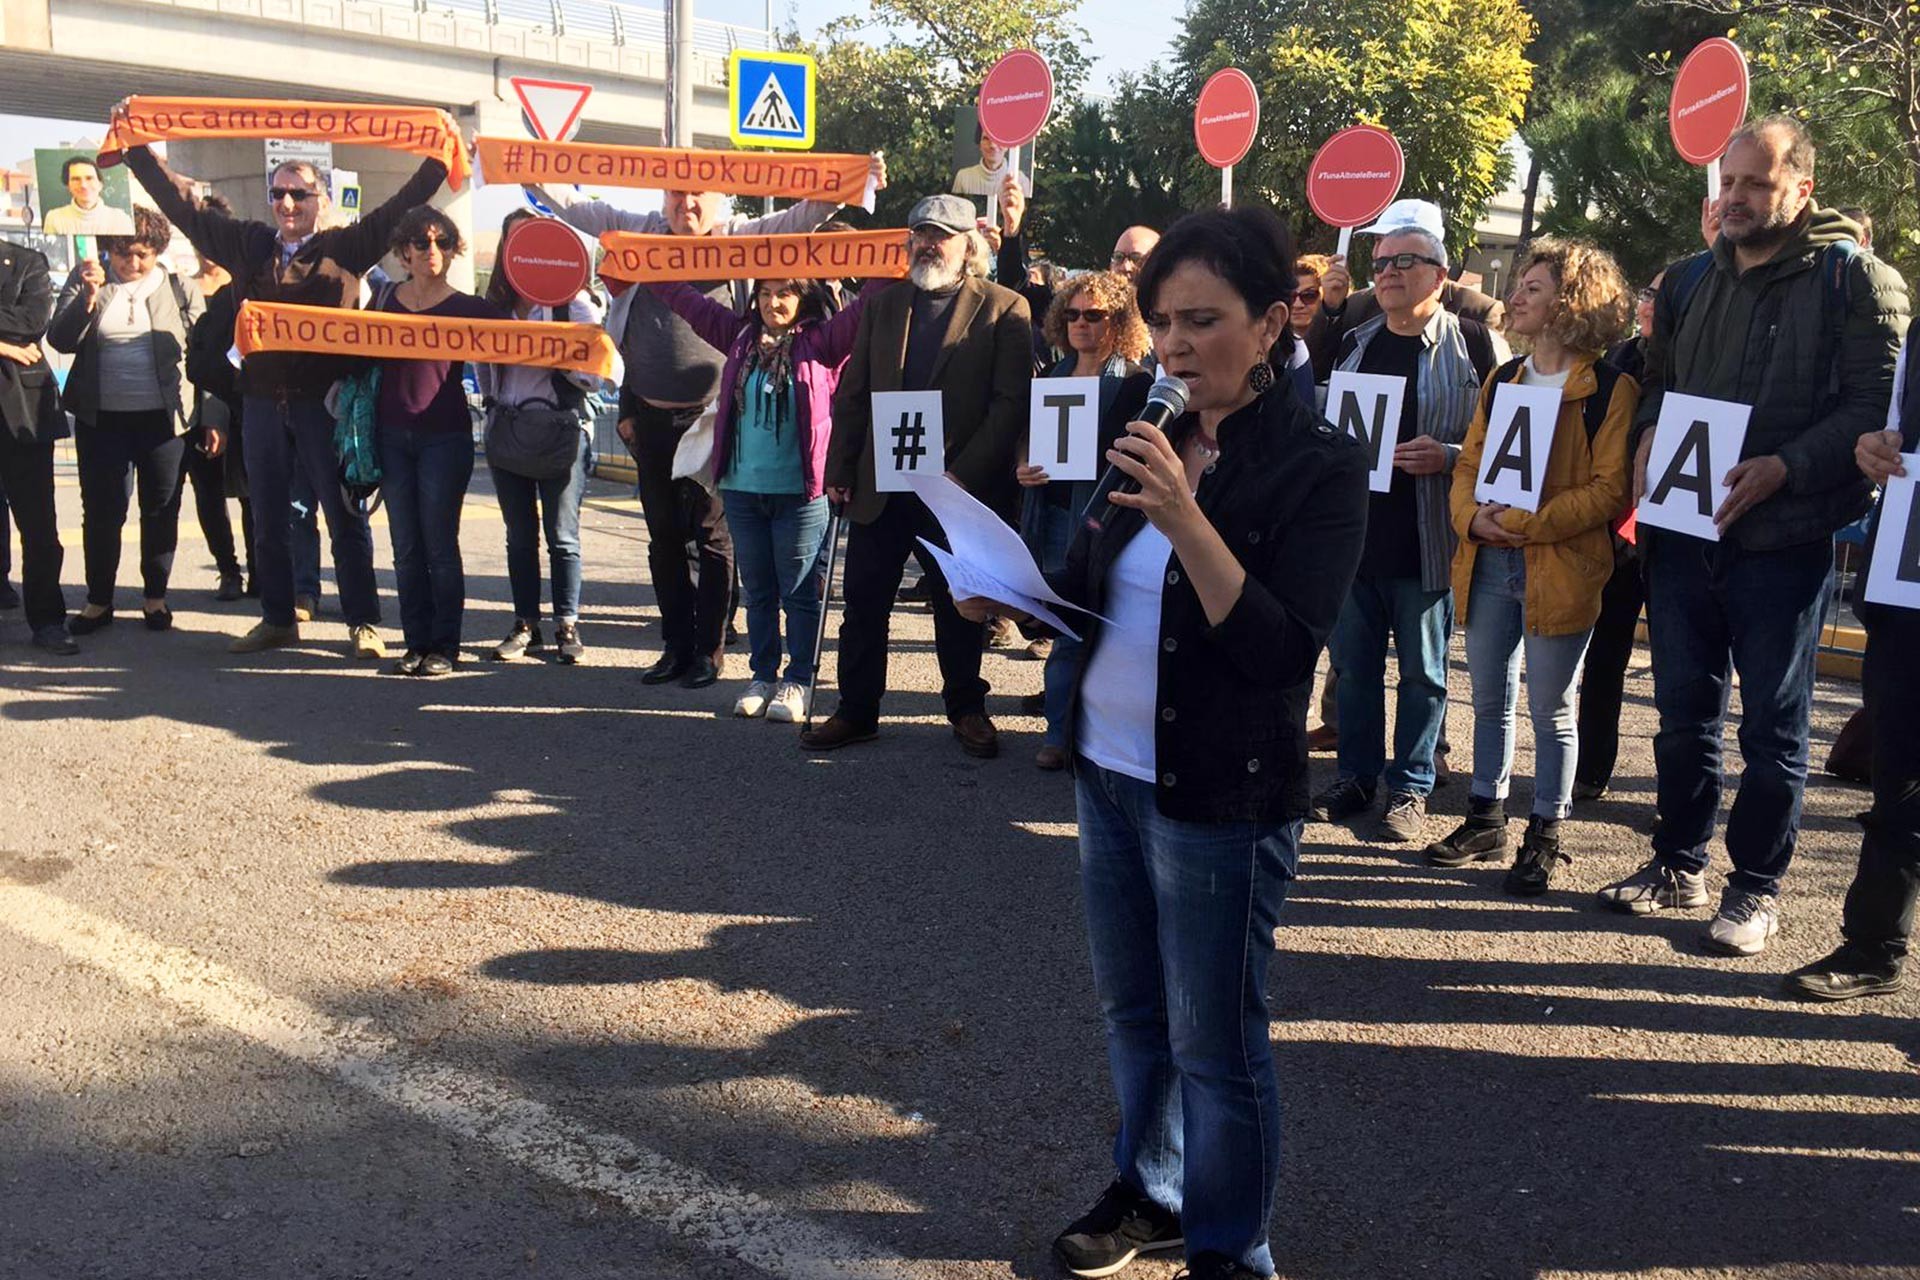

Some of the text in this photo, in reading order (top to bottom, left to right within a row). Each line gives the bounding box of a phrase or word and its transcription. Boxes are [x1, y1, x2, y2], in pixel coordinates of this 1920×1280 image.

[504, 145, 841, 192] #hocamadokunma
[245, 311, 591, 362] #hocamadokunma
[891, 412, 926, 470] #
[1043, 394, 1085, 463] T
[1338, 390, 1389, 471] N
[1484, 406, 1532, 492] A
[1649, 420, 1713, 517] A
